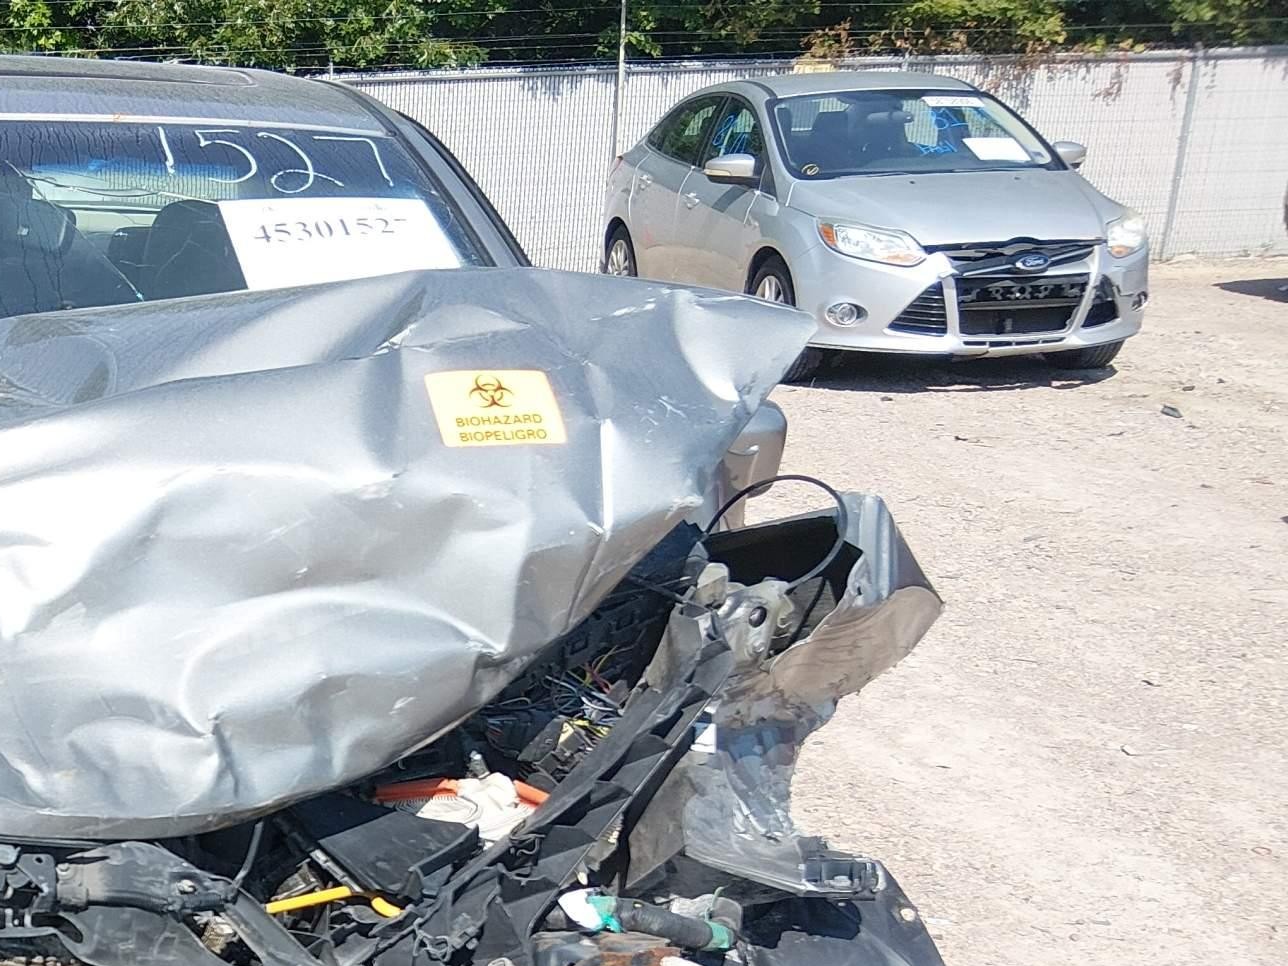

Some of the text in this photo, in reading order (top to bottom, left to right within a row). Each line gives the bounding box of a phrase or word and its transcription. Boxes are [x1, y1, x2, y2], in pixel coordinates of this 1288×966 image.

[156, 125, 395, 194] 1527
[455, 413, 543, 428] BIOHAZARD
[458, 428, 548, 442] BIOPELIGRO
